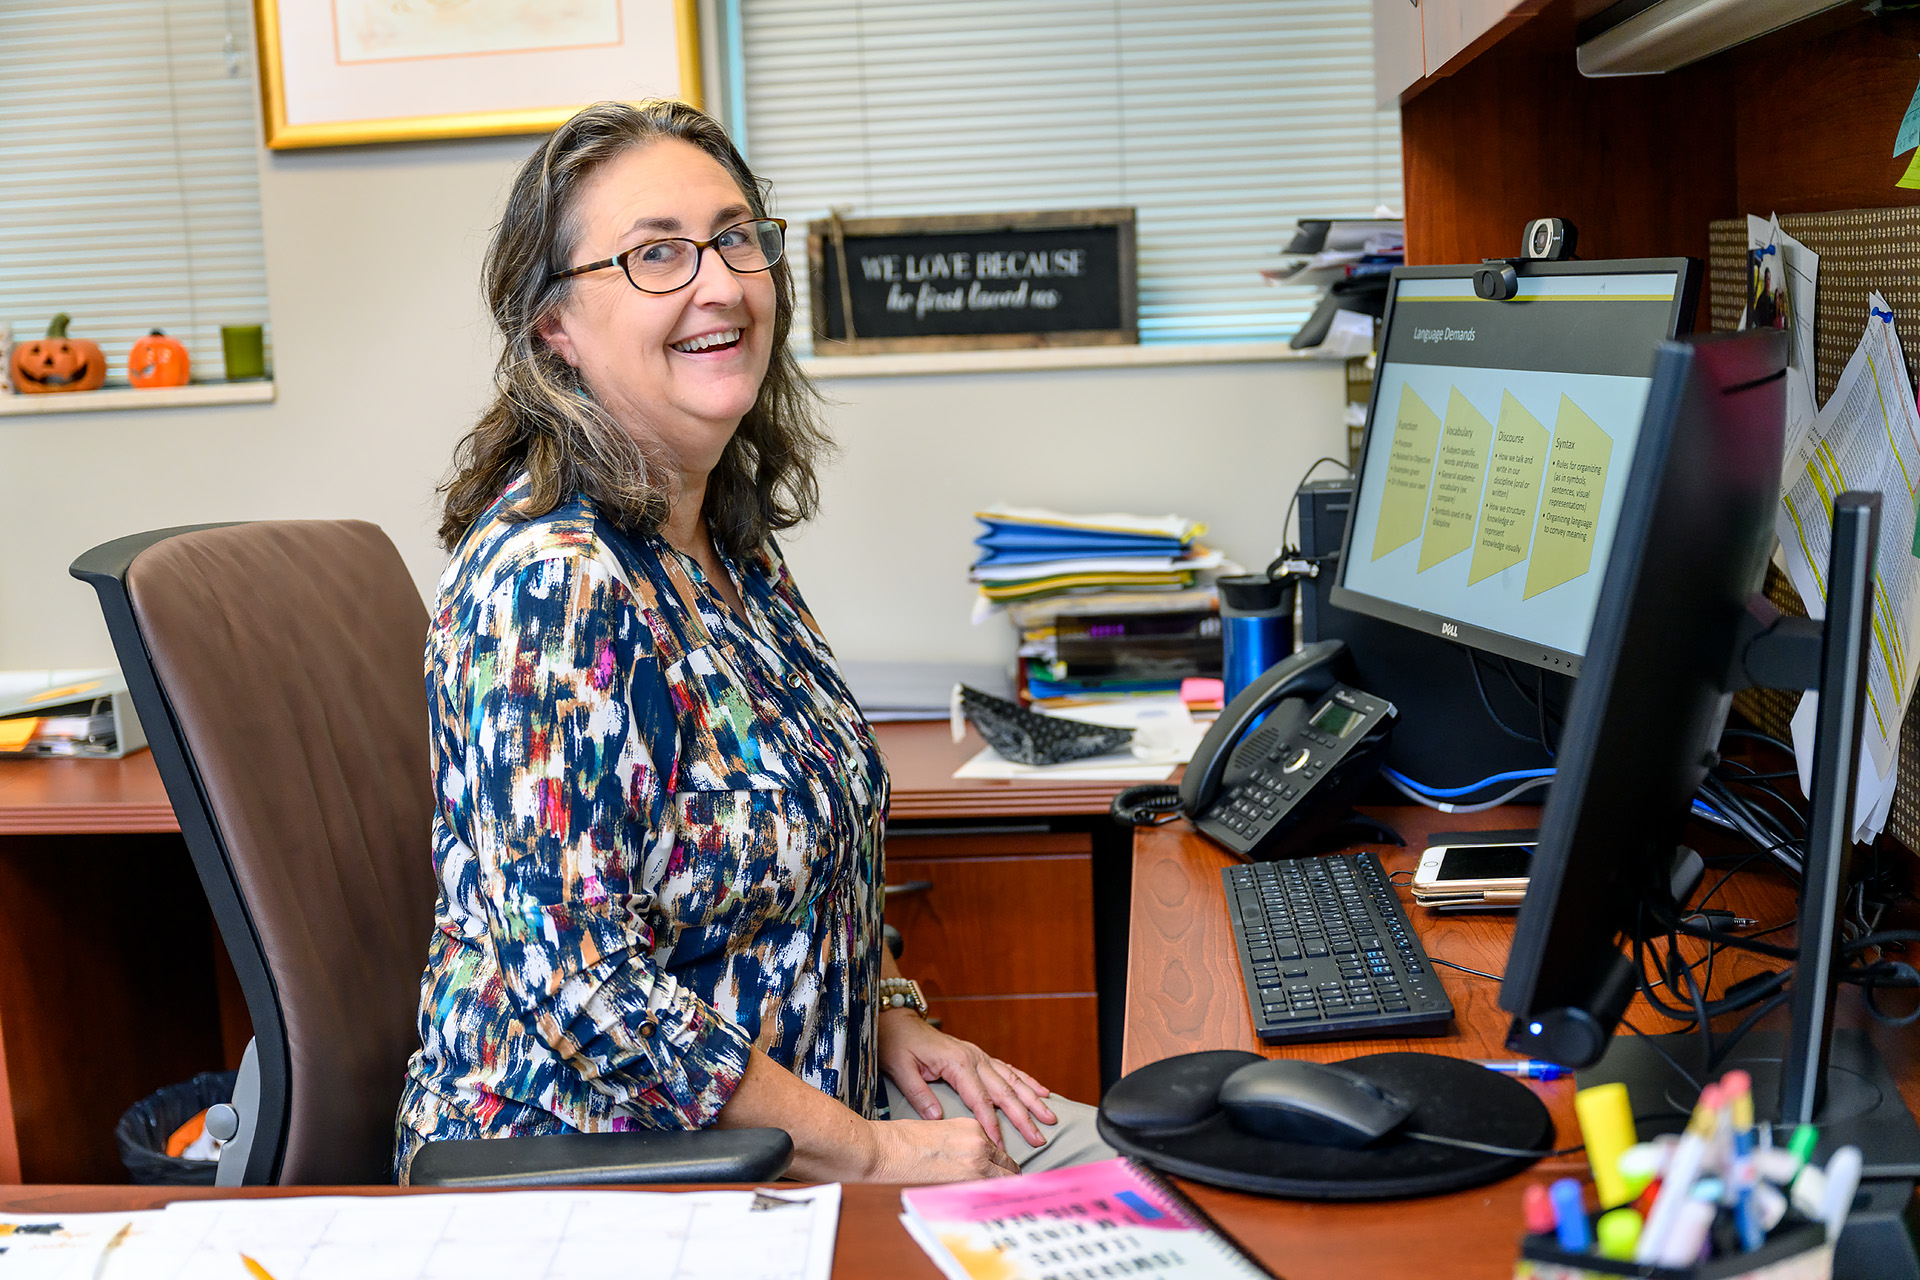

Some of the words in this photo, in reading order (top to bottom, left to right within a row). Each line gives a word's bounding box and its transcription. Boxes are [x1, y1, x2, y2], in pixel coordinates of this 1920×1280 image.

[861, 255, 901, 281] WE
[906, 252, 970, 281] LOVE
[976, 249, 1086, 279] BECAUSE
[886, 281, 914, 312] he
[916, 281, 964, 321] first
[968, 280, 1029, 310] loved
[1031, 286, 1062, 309] us
[1413, 326, 1444, 343] Language
[1444, 327, 1476, 341] Demands
[1398, 420, 1418, 430] Function
[1447, 426, 1473, 439] Vocabulary
[1498, 431, 1524, 443] Discourse
[1556, 438, 1576, 450] Syntax
[1446, 446, 1476, 456] Subject-specific
[1464, 460, 1479, 469] phrases
[1498, 453, 1508, 461] How
[1516, 455, 1524, 463] talk
[1525, 456, 1534, 464] and
[1496, 465, 1507, 473] write
[1556, 460, 1569, 470] Rules
[1569, 461, 1577, 470] for
[1577, 464, 1601, 475] organizing
[1457, 473, 1475, 482] academic
[1494, 476, 1513, 488] discipline
[1514, 480, 1524, 489] (oral
[1567, 475, 1586, 486] symbols,
[1440, 483, 1459, 494] vocabulary
[1492, 489, 1509, 500] written)
[1551, 486, 1575, 498] sentences,
[1576, 489, 1590, 498] visual
[1506, 506, 1526, 516] structure
[1549, 499, 1587, 512] representations)
[1487, 514, 1509, 527] knowledge
[1546, 512, 1570, 526] Organizing
[1571, 516, 1593, 529] language
[1484, 527, 1505, 537] represent
[1544, 525, 1549, 533] to
[1550, 526, 1566, 538] convey
[1567, 529, 1588, 542] meaning
[1482, 539, 1504, 551] knowledge
[1505, 543, 1521, 554] visually
[1441, 622, 1458, 638] DELL
